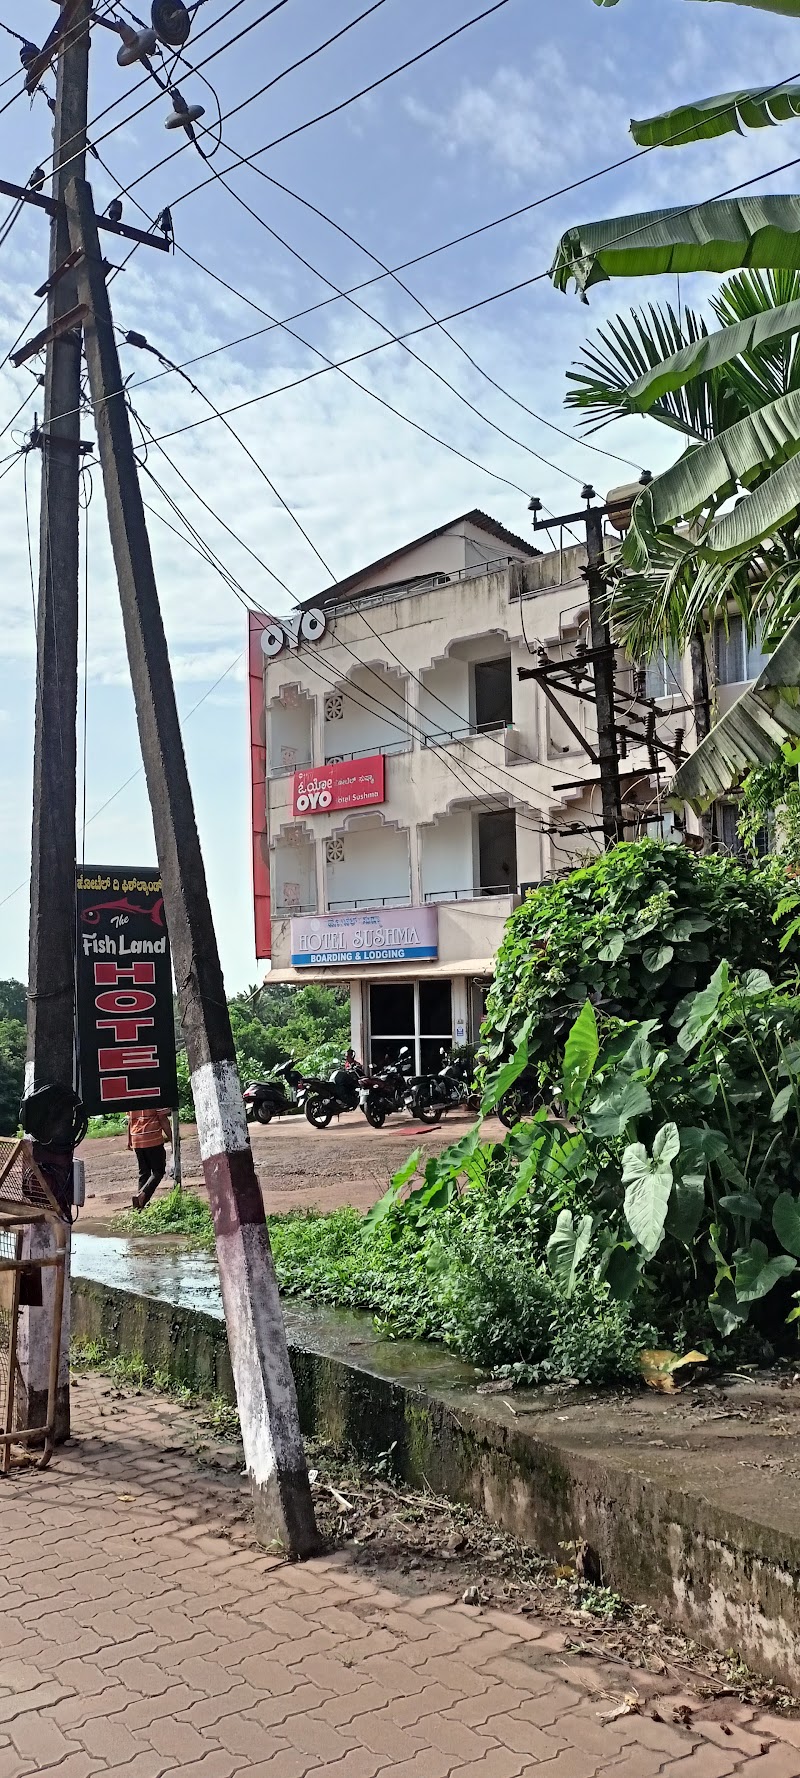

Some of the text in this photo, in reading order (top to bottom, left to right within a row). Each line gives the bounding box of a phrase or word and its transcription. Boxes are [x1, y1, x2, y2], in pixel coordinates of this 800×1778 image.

[261, 608, 327, 656] OYO
[297, 791, 332, 811] OYO
[336, 792, 379, 804] otel Sushma
[110, 914, 130, 928] The
[82, 933, 166, 956] Fish Land
[299, 926, 421, 952] HOTEL SUSHMA
[310, 949, 405, 963] BOARDING & LODGING
[94, 961, 161, 1101] HOTEL
